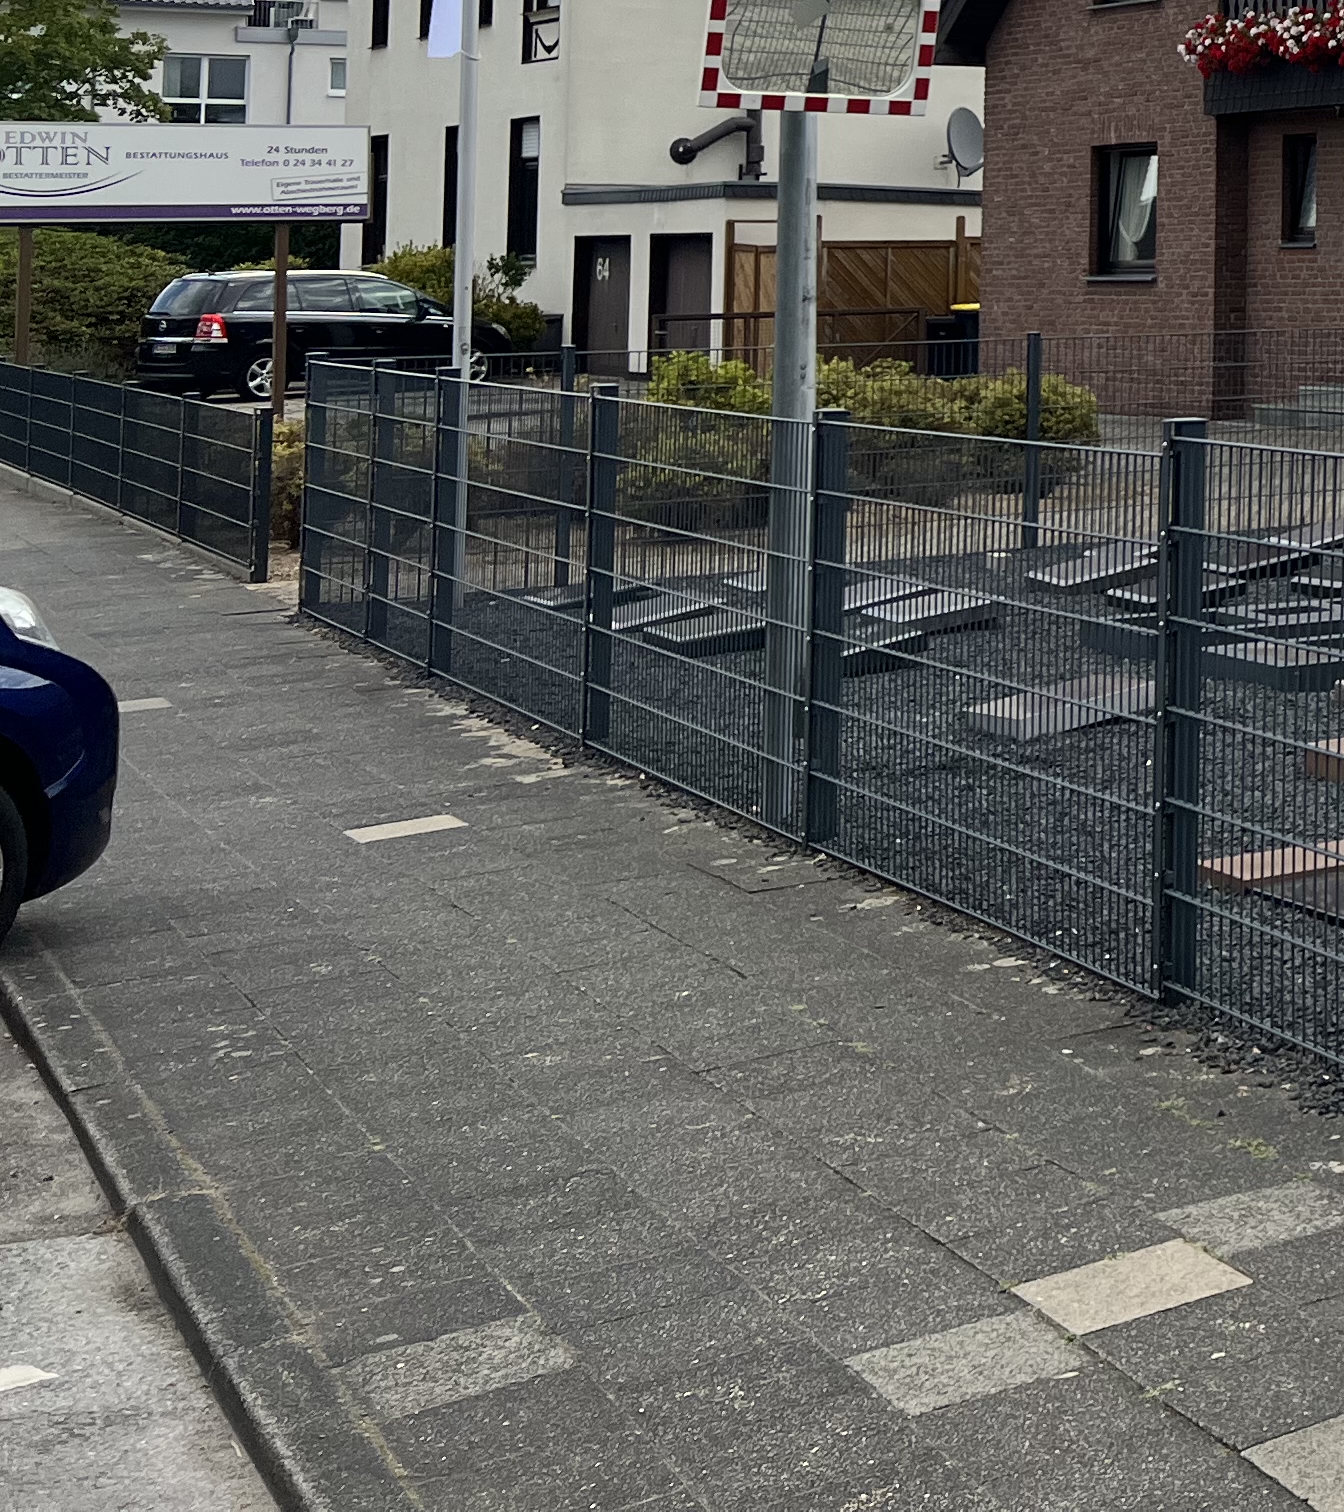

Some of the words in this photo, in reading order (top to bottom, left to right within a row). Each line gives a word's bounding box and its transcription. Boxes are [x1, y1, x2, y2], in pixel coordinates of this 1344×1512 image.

[4, 131, 89, 145] EDWIN
[267, 146, 280, 154] 24
[284, 146, 328, 154] Stunden
[125, 151, 229, 159] BESTATTUNGSHAUS
[240, 159, 279, 167] Telefon
[283, 159, 290, 167] 0
[293, 159, 306, 167] 24
[309, 159, 322, 167] 34
[326, 159, 337, 167] 41
[341, 159, 354, 167] 27
[230, 205, 361, 215] www.otten-wegberg.de
[596, 257, 610, 281] 64
